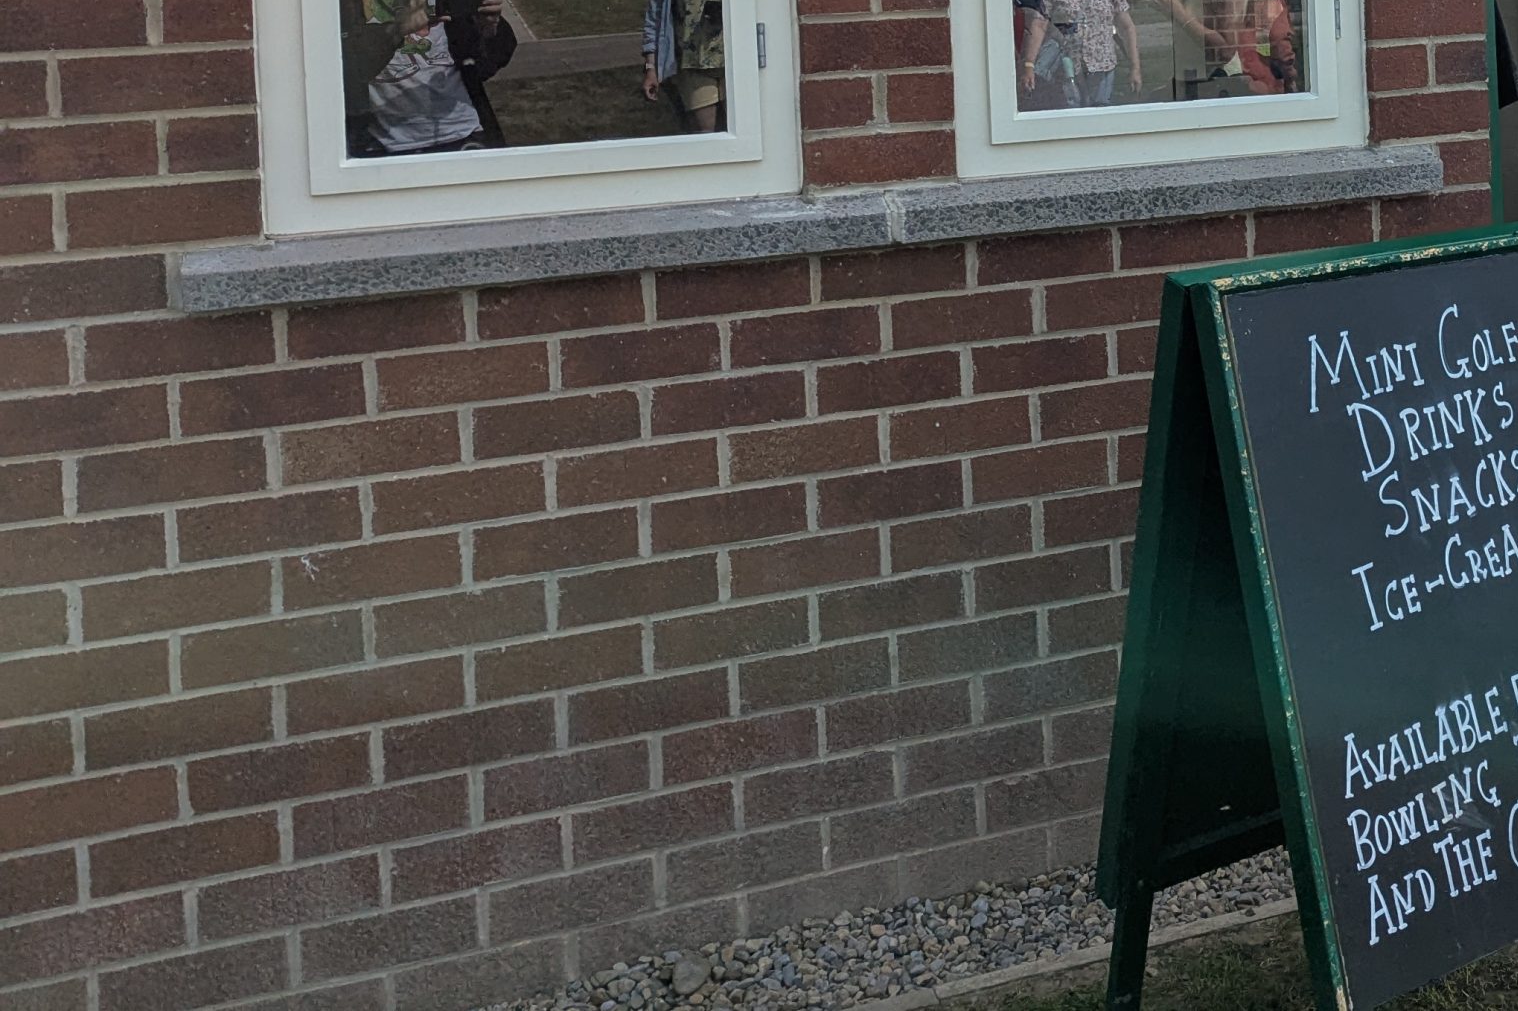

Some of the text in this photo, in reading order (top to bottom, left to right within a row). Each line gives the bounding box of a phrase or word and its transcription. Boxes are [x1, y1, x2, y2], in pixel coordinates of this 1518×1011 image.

[1308, 304, 1518, 412] MINI GOLF
[1346, 382, 1514, 482] DRINKS
[1344, 686, 1508, 799] AVAILABLE
[1347, 760, 1501, 871] BOWLING
[1368, 869, 1435, 946] AND
[1434, 833, 1497, 897] THE
